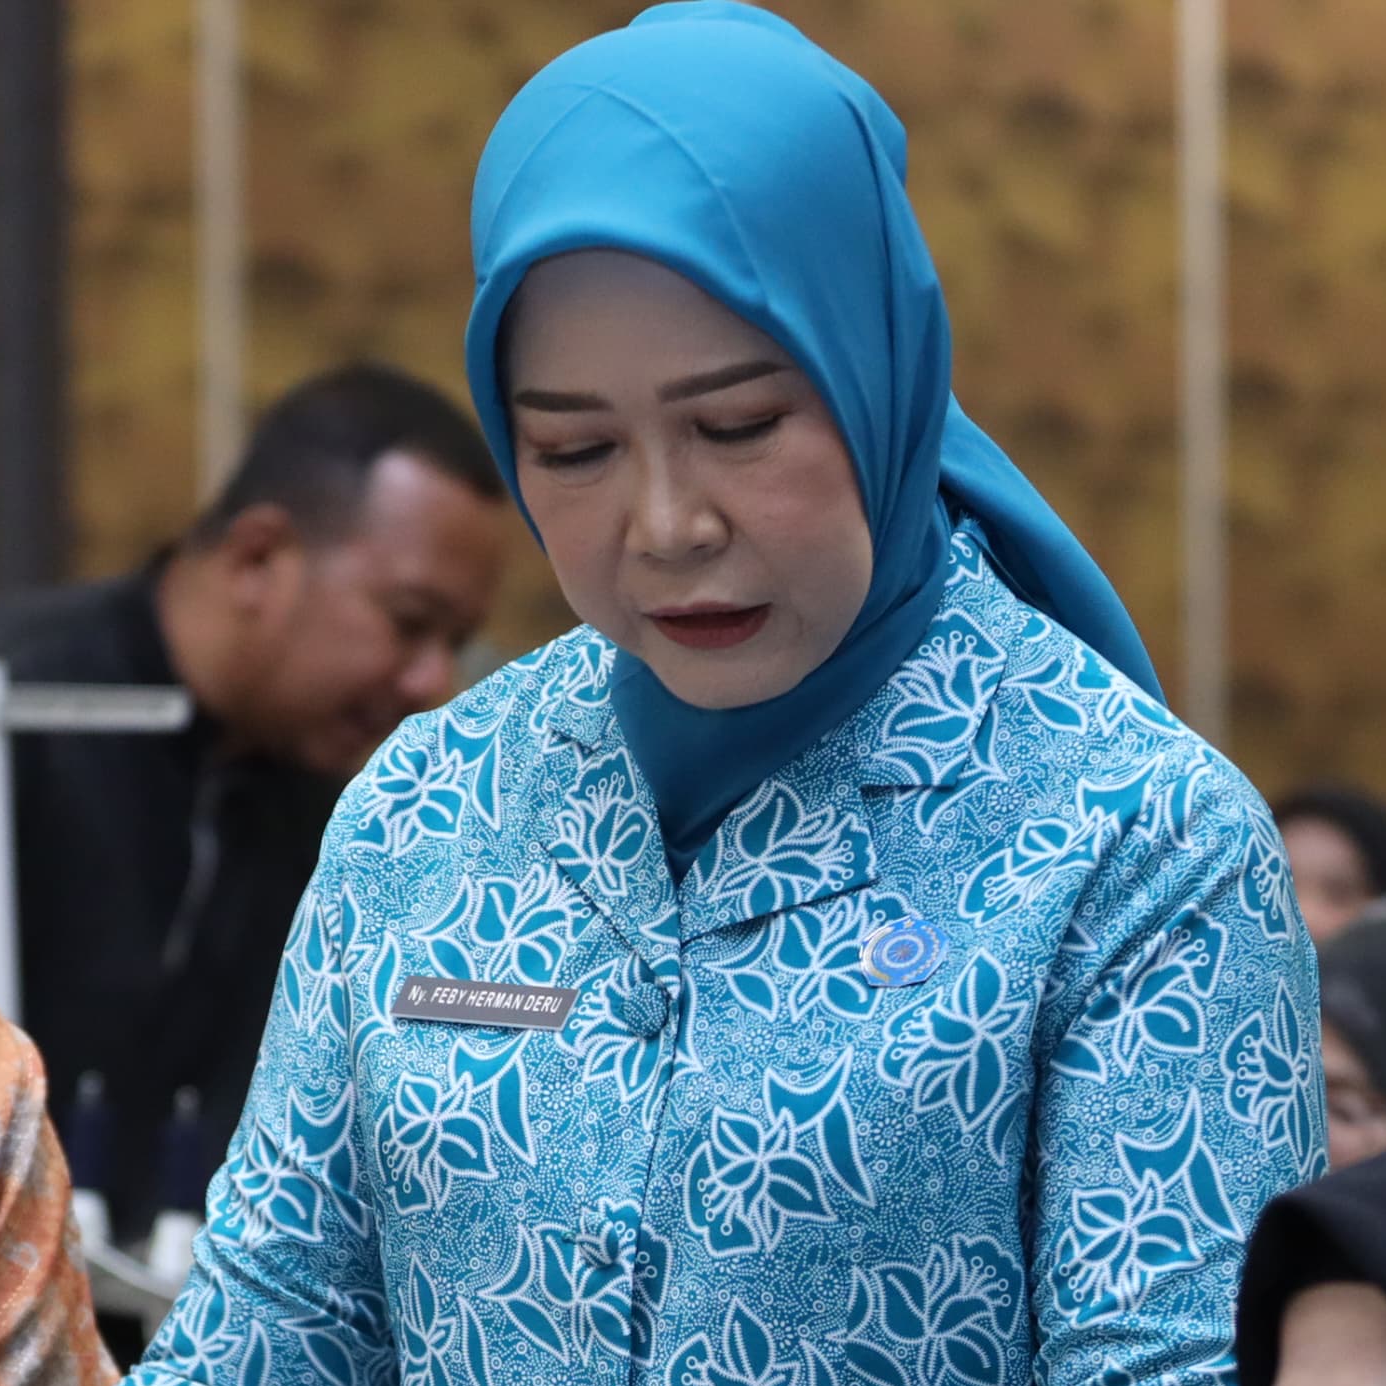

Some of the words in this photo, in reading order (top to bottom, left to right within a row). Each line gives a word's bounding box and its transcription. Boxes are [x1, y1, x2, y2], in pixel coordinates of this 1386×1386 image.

[407, 985, 427, 1006] Ny.
[430, 986, 468, 1006] FEBY
[465, 990, 525, 1011] HERMAN
[523, 994, 563, 1014] DERU
